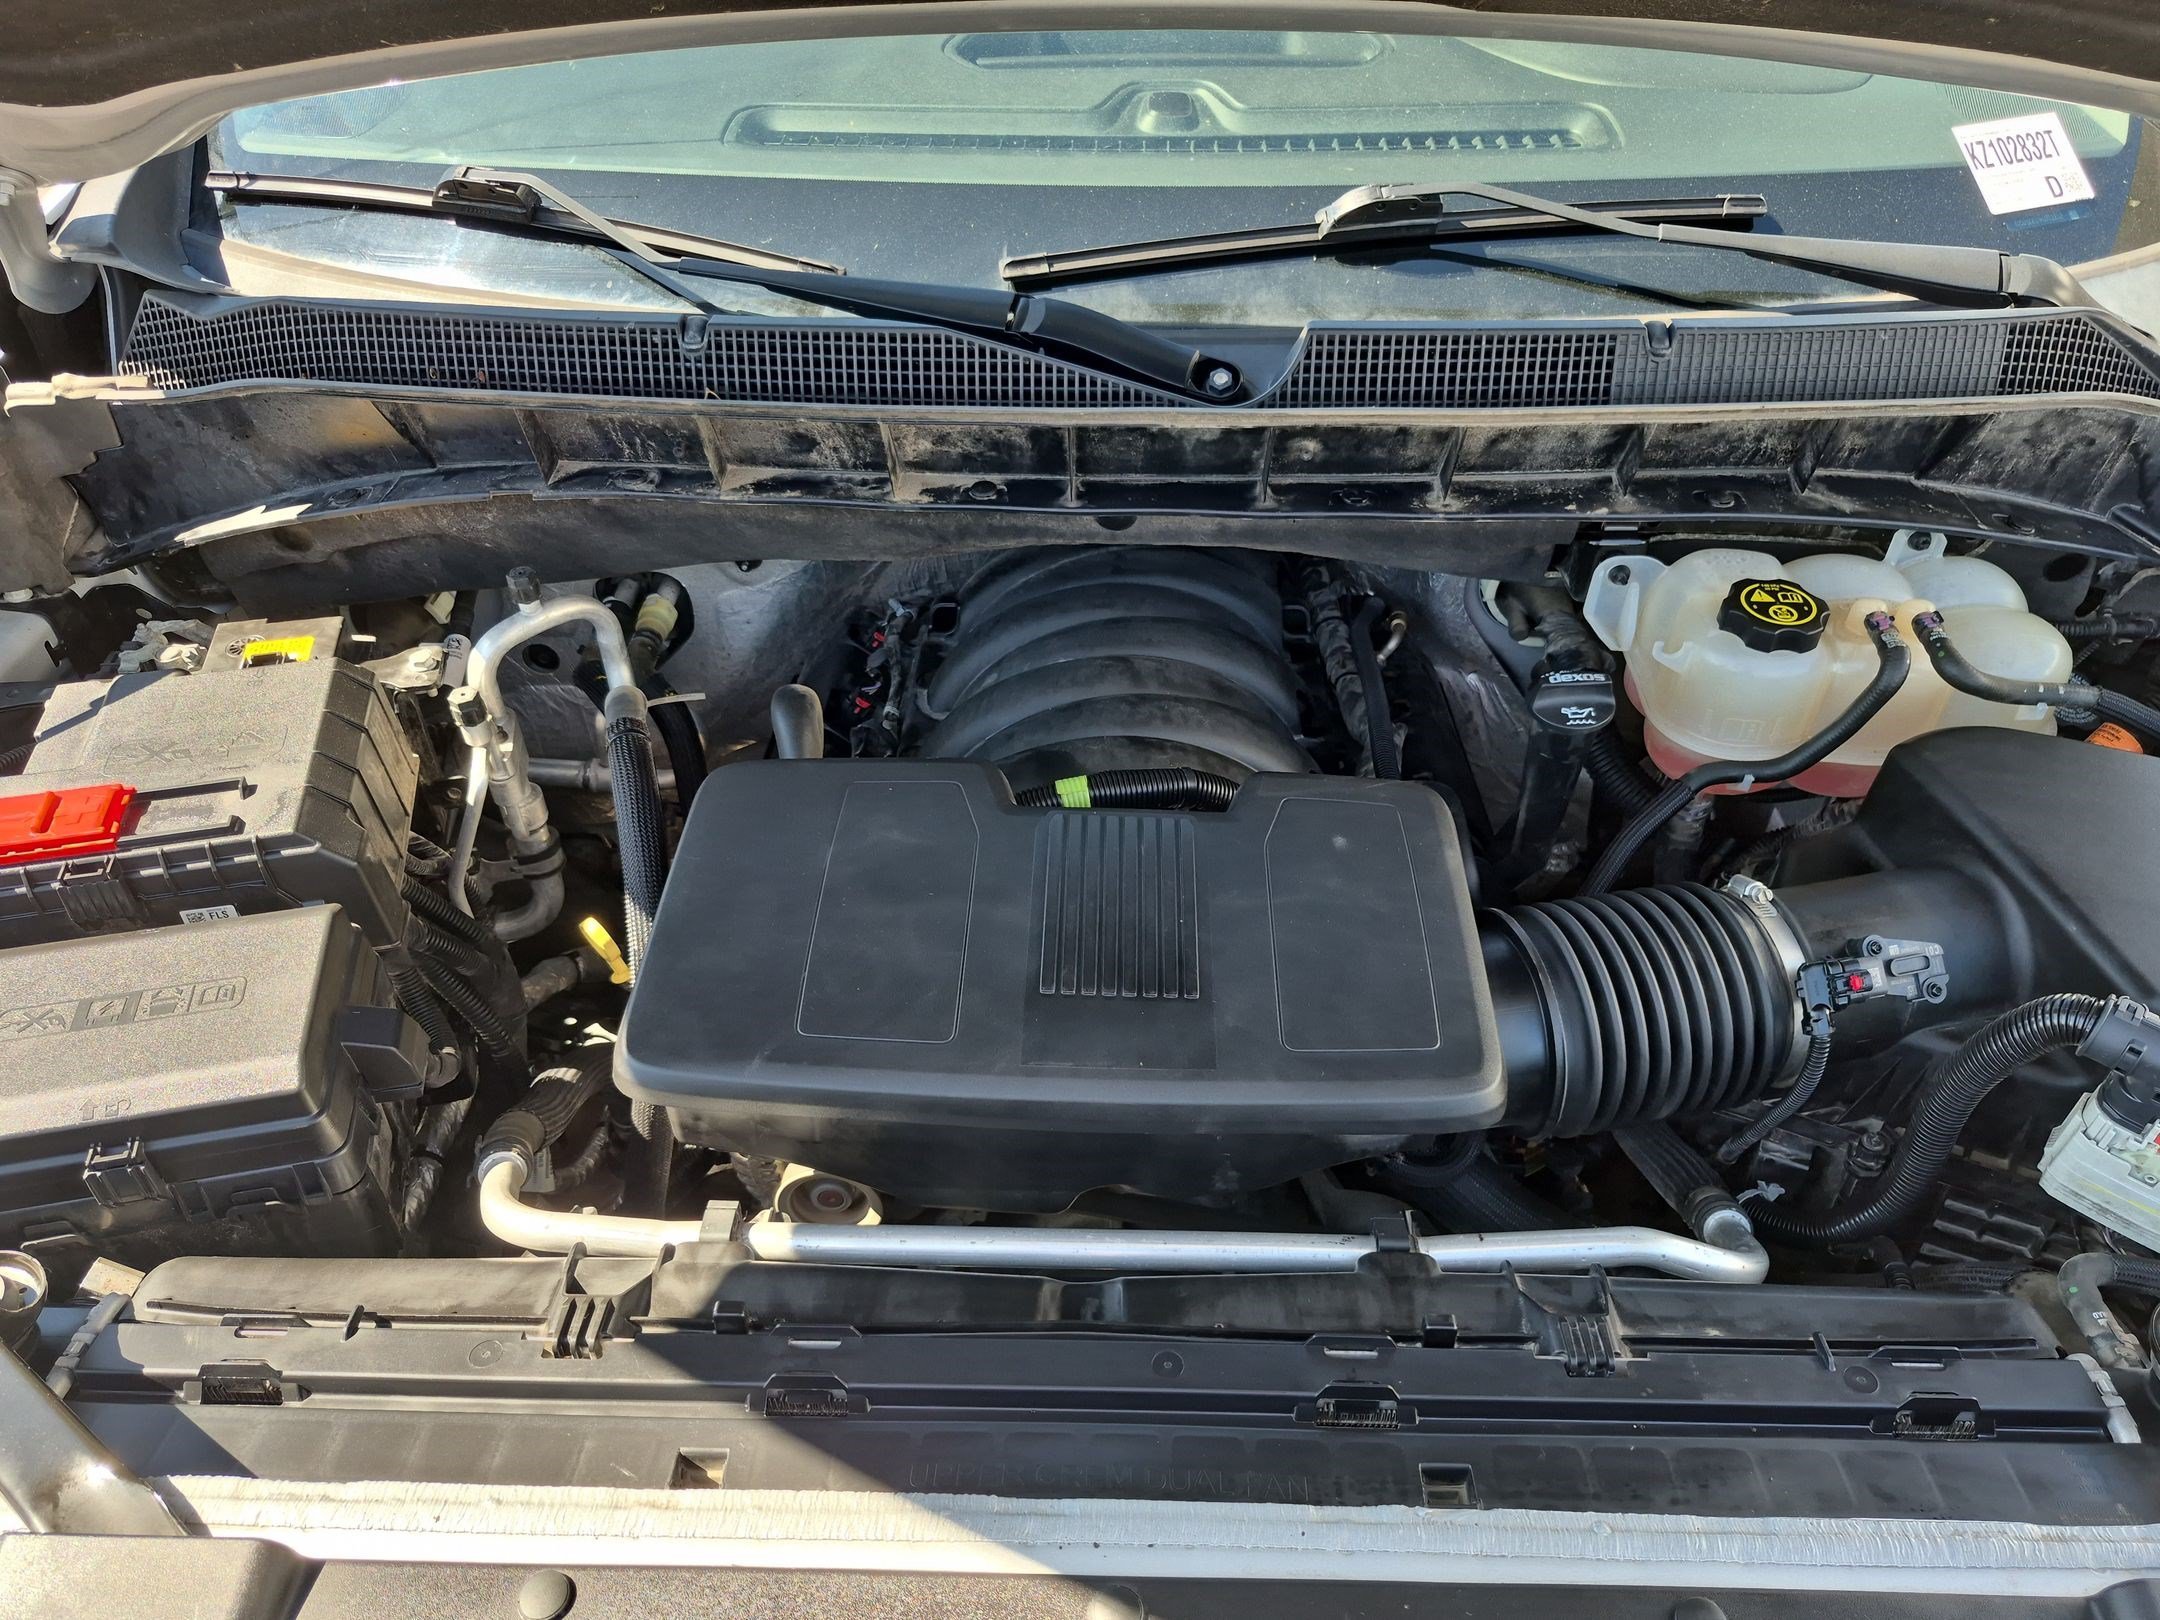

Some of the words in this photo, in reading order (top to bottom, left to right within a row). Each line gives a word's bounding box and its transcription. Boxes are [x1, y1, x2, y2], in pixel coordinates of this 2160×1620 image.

[1964, 130, 2060, 169] KZ102832T
[2045, 176, 2063, 197] D
[1548, 673, 1605, 683] dexos
[208, 911, 230, 920] FLS
[909, 1463, 1026, 1489] UPPER
[1147, 1468, 1236, 1497] DUAL
